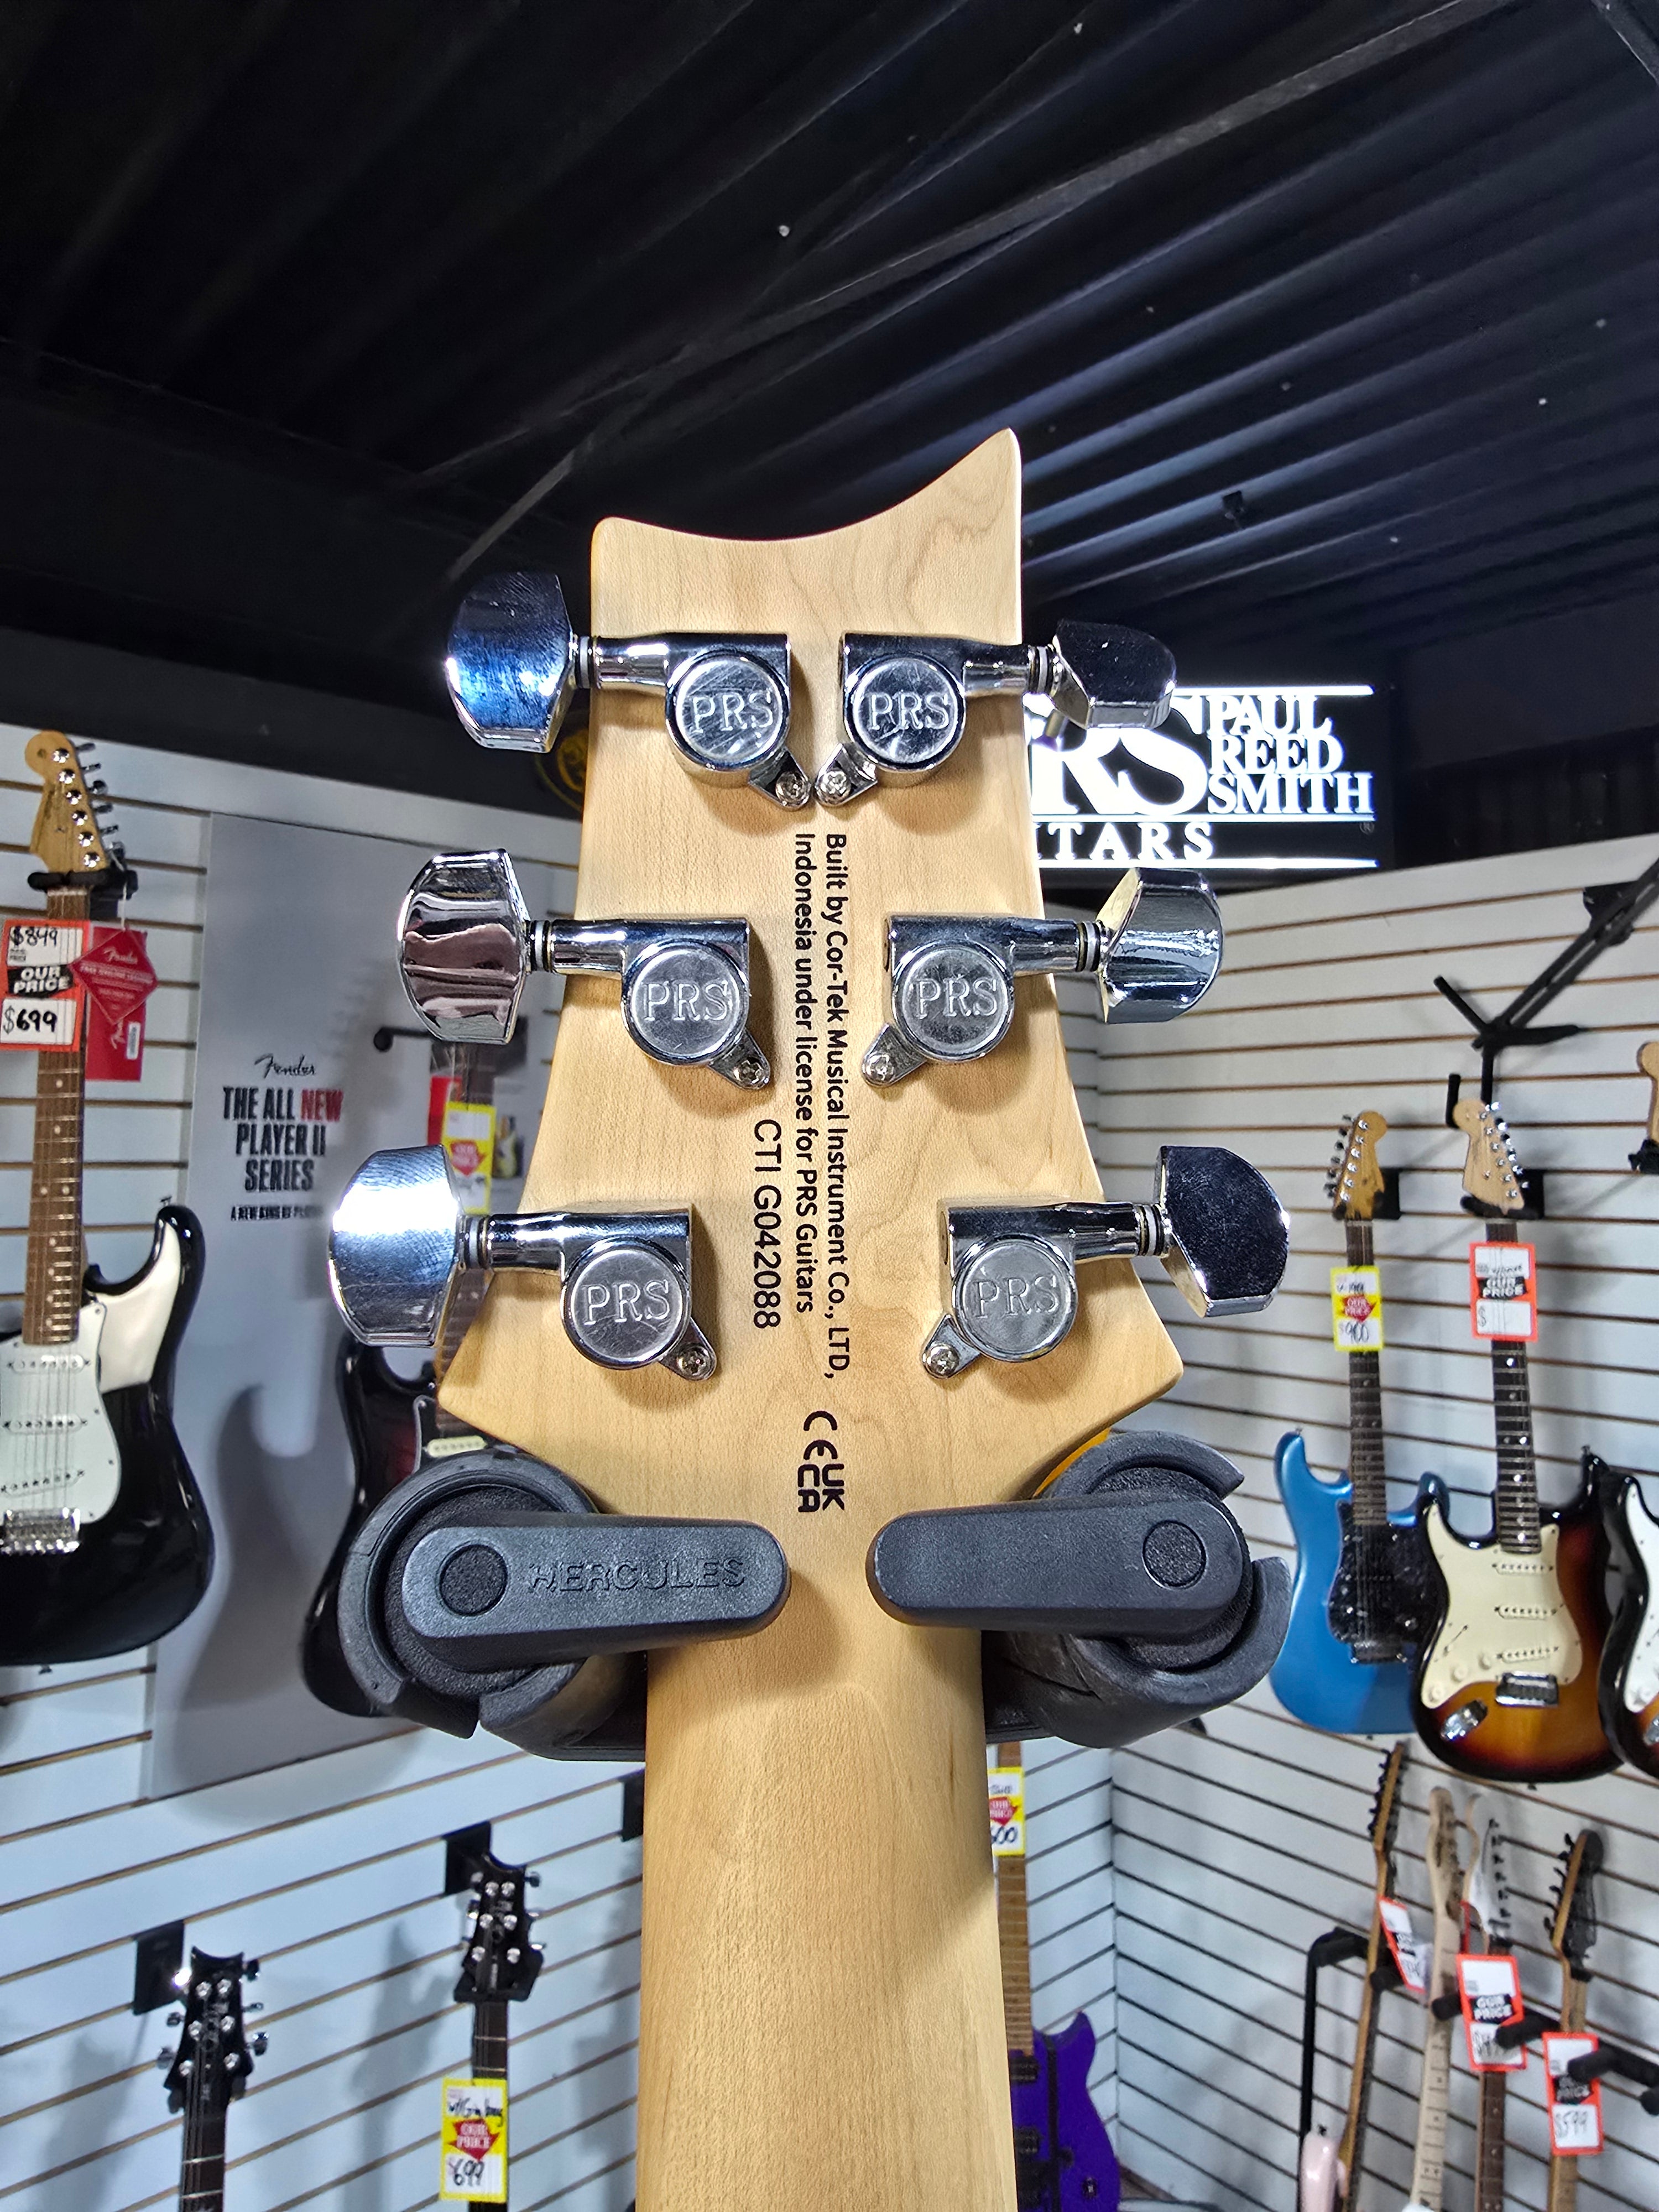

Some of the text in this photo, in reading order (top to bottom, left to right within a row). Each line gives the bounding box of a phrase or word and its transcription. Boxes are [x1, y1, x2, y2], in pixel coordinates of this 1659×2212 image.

[691, 691, 774, 733] PRS
[868, 691, 949, 731] PRS
[1208, 695, 1333, 735] PAUL
[1208, 733, 1345, 774] REED
[1208, 772, 1375, 814] SMITH
[13, 976, 70, 994] PRICE
[21, 966, 60, 980] OUR
[642, 979, 729, 1021] PRS
[915, 976, 998, 1019] PRS
[3, 1005, 58, 1034] $699
[254, 1053, 316, 1078] Fender
[795, 833, 819, 1313] Indonesia under license for PRS Guitars
[223, 1087, 343, 1122] THE ALL NEW
[821, 833, 850, 1379] Built by Cor-Tek Musical Instrument Co., LTD,
[236, 1123, 326, 1156] PLAYER II
[245, 1159, 314, 1192] SERIES
[753, 1119, 782, 1329] CTI G042088
[582, 1279, 671, 1326] PRS
[971, 1275, 1059, 1318] PRS
[528, 1557, 745, 1593] HERCULES
